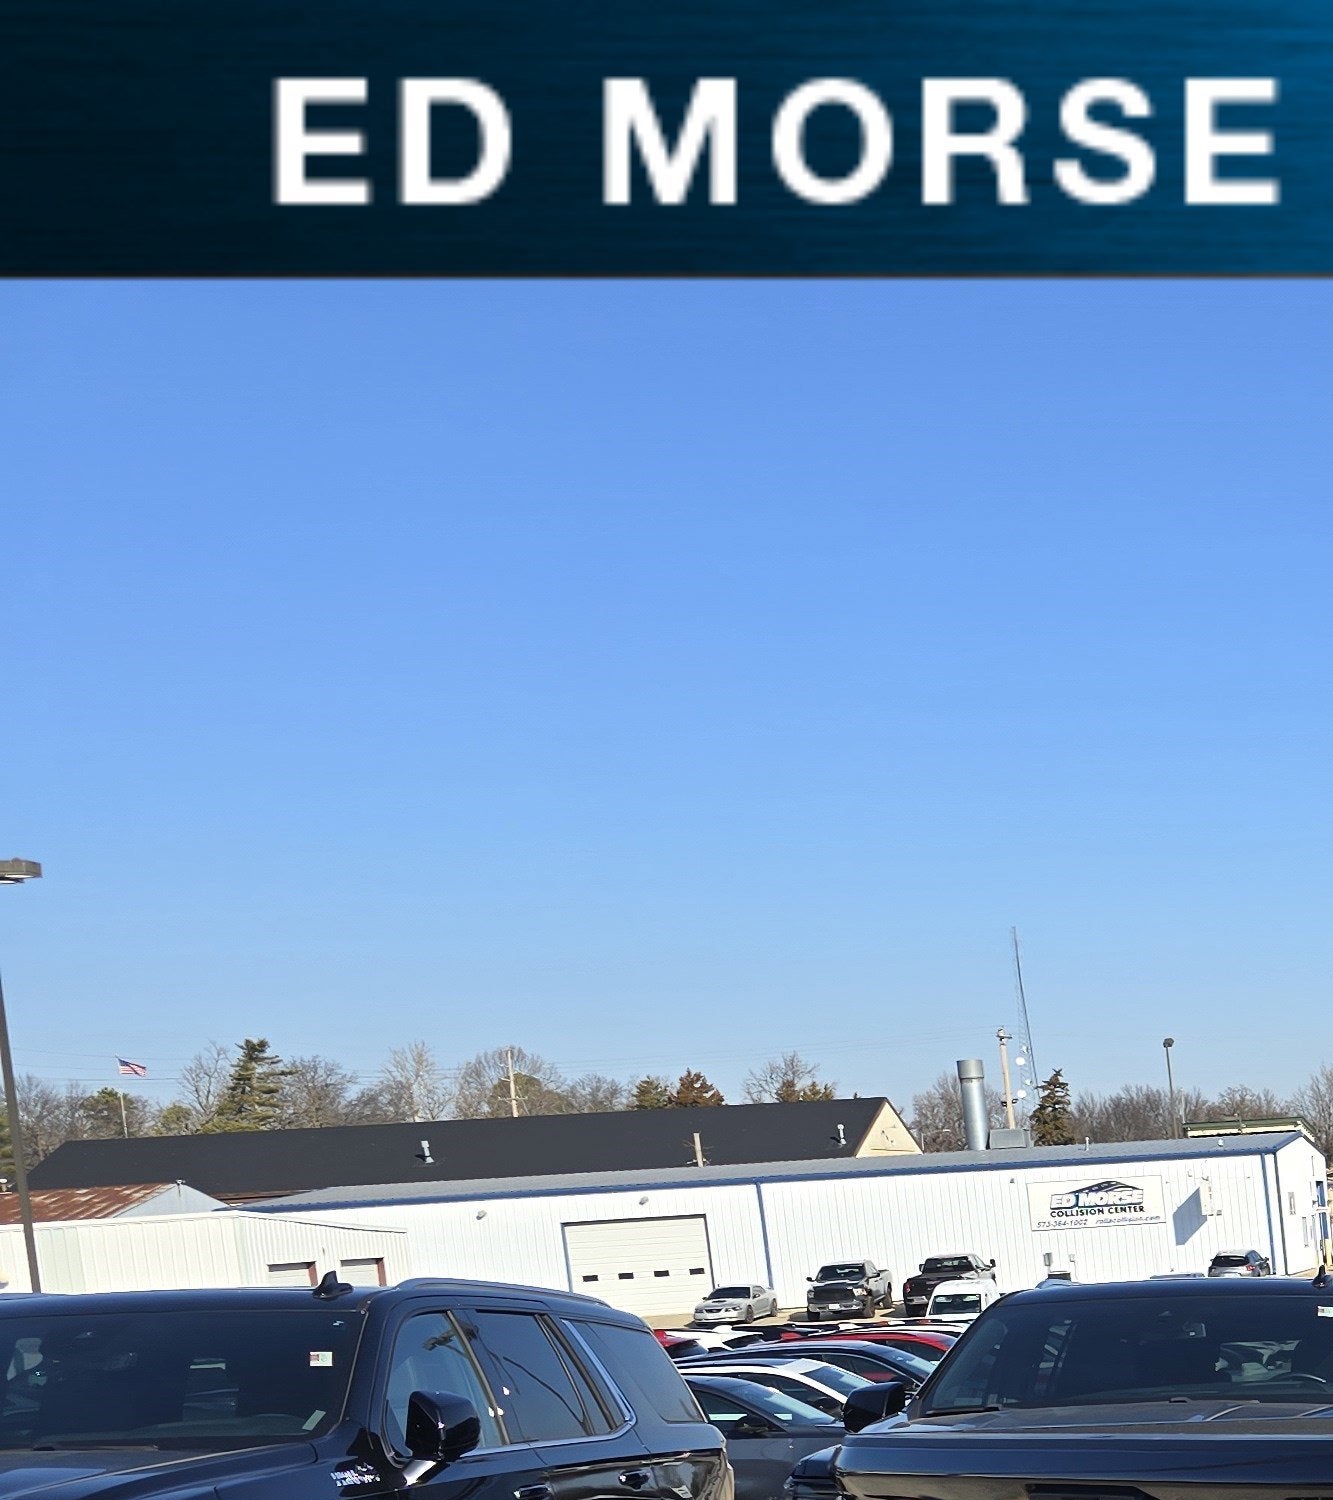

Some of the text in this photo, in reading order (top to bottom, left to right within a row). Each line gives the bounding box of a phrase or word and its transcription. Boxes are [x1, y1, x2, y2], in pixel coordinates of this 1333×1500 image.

[1050, 1189, 1144, 1210] ED MORSE
[1049, 1204, 1145, 1218] COLLISION CENTER
